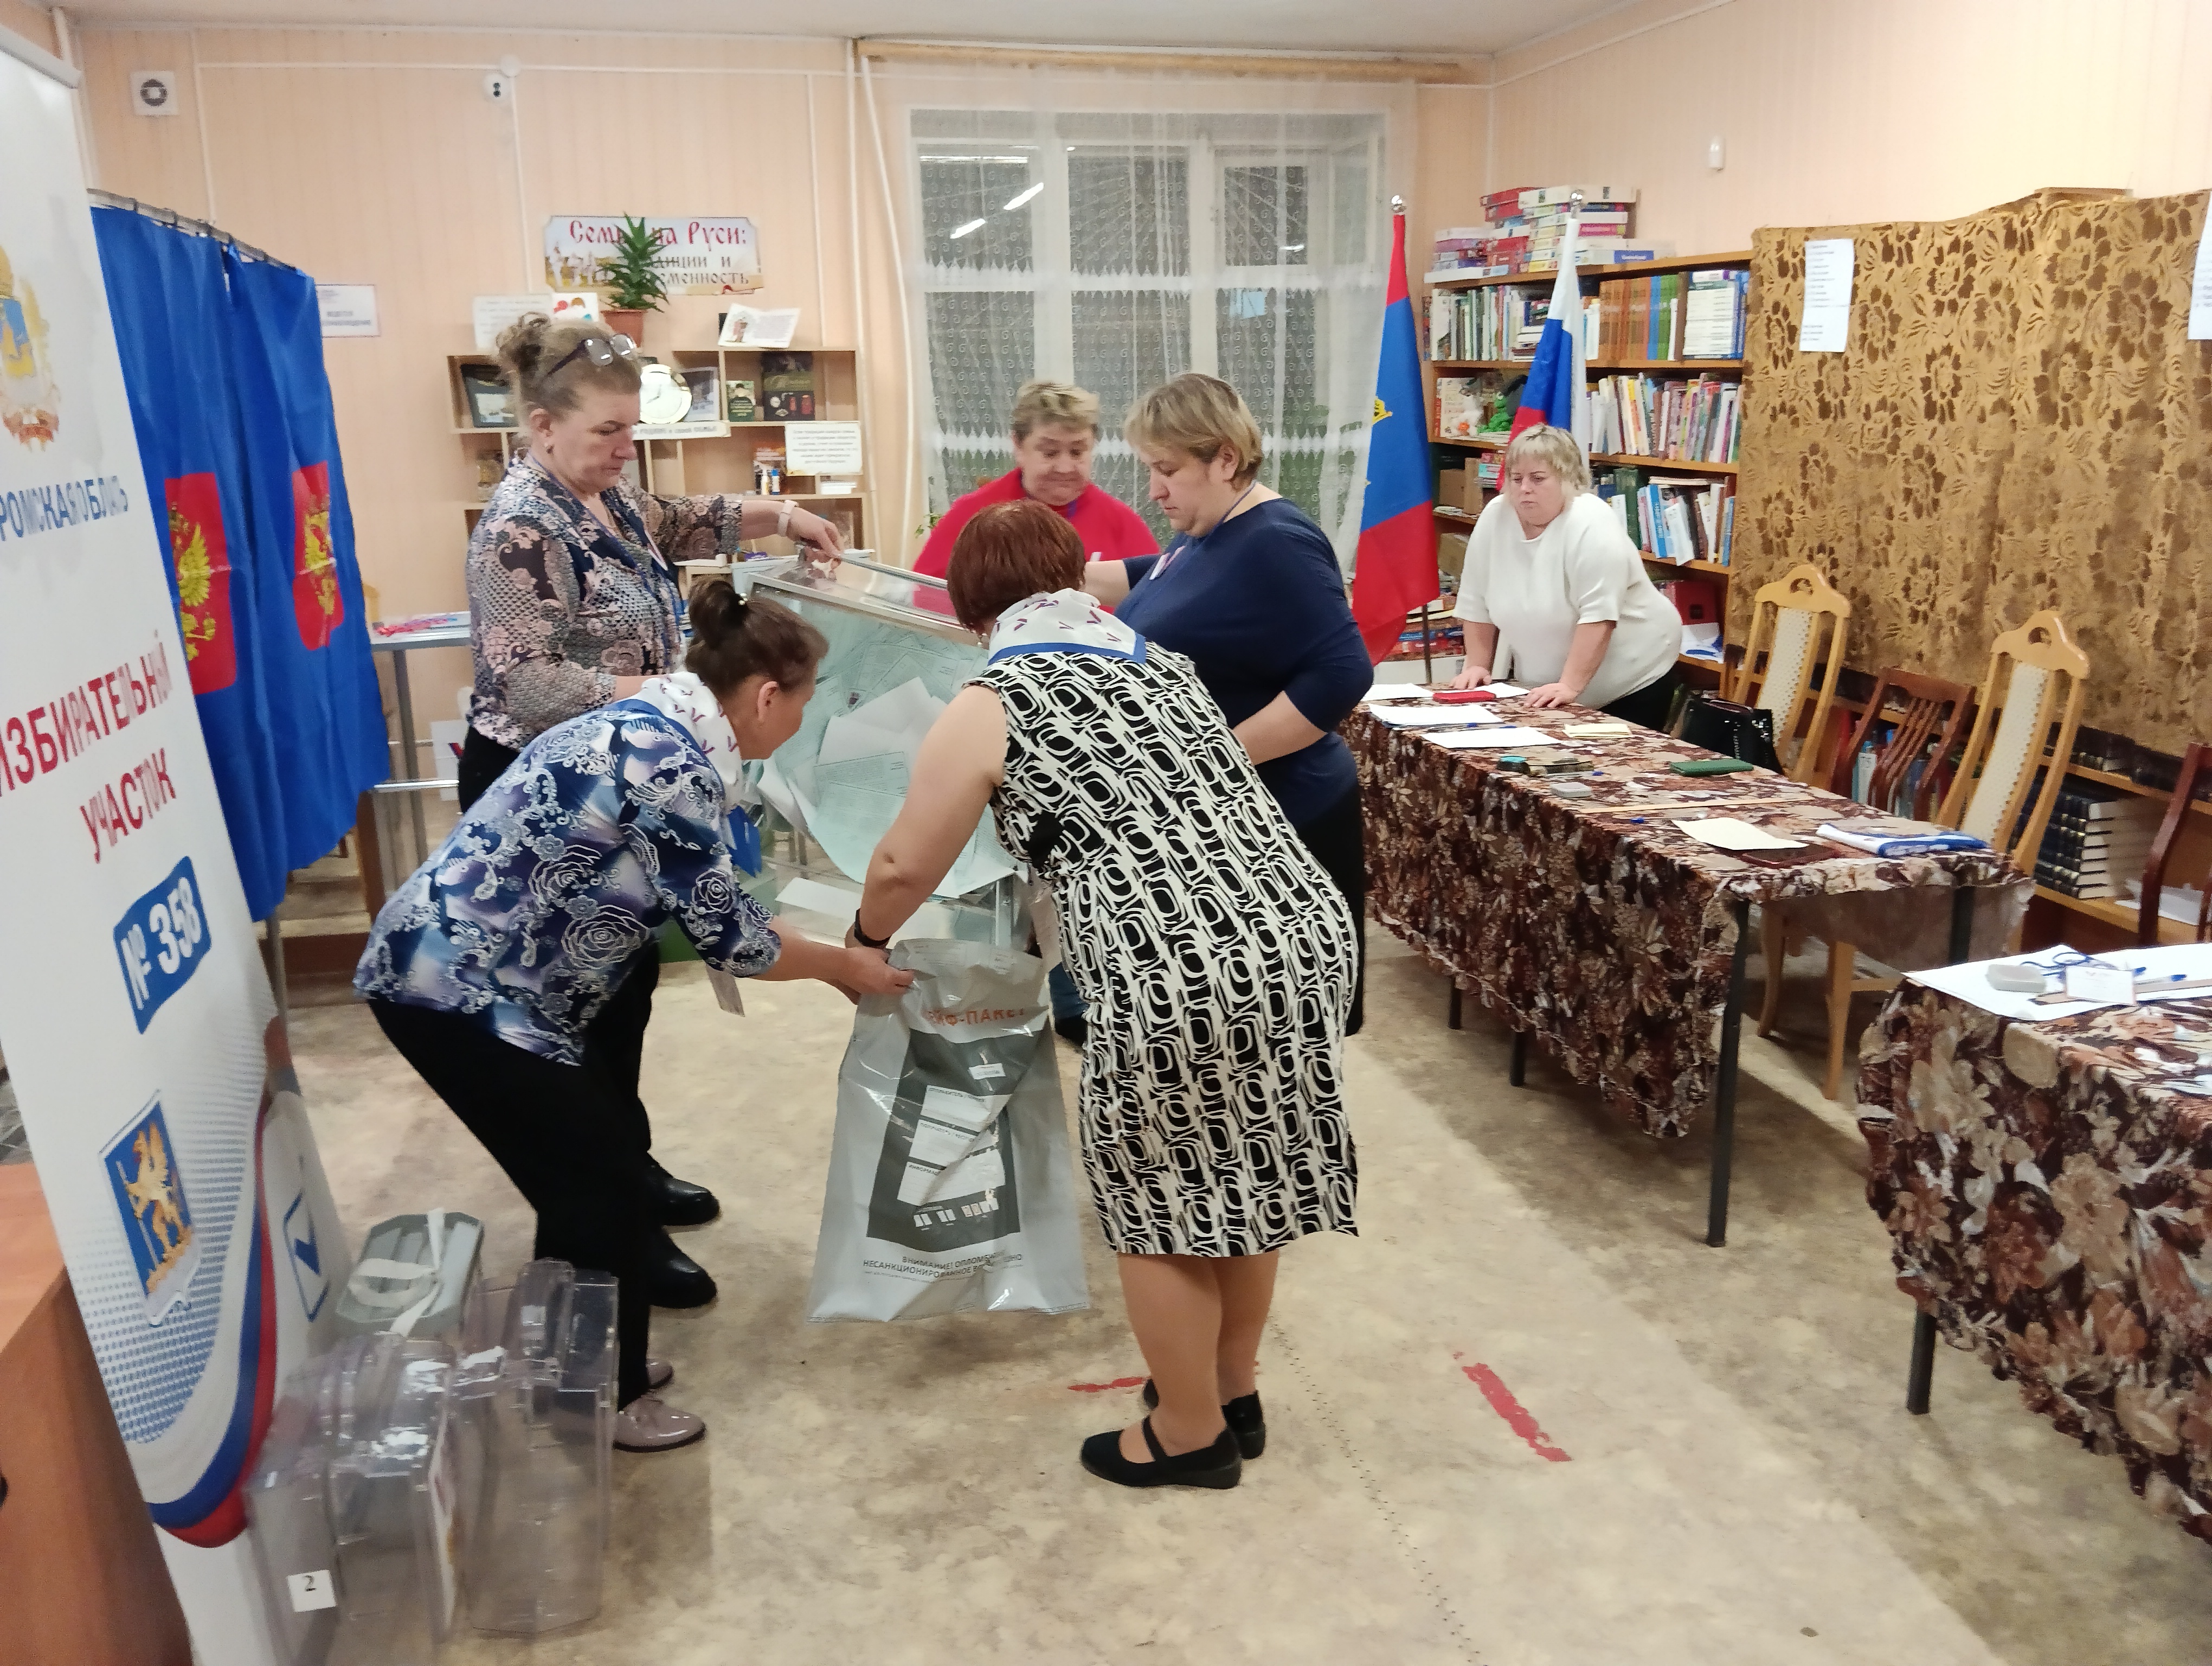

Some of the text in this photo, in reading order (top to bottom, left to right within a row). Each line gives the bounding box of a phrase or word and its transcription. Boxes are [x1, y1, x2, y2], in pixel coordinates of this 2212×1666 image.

[689, 222, 746, 252] Руси:
[722, 257, 730, 267] и
[149, 876, 202, 975] 358
[304, 1574, 317, 1592] 2
